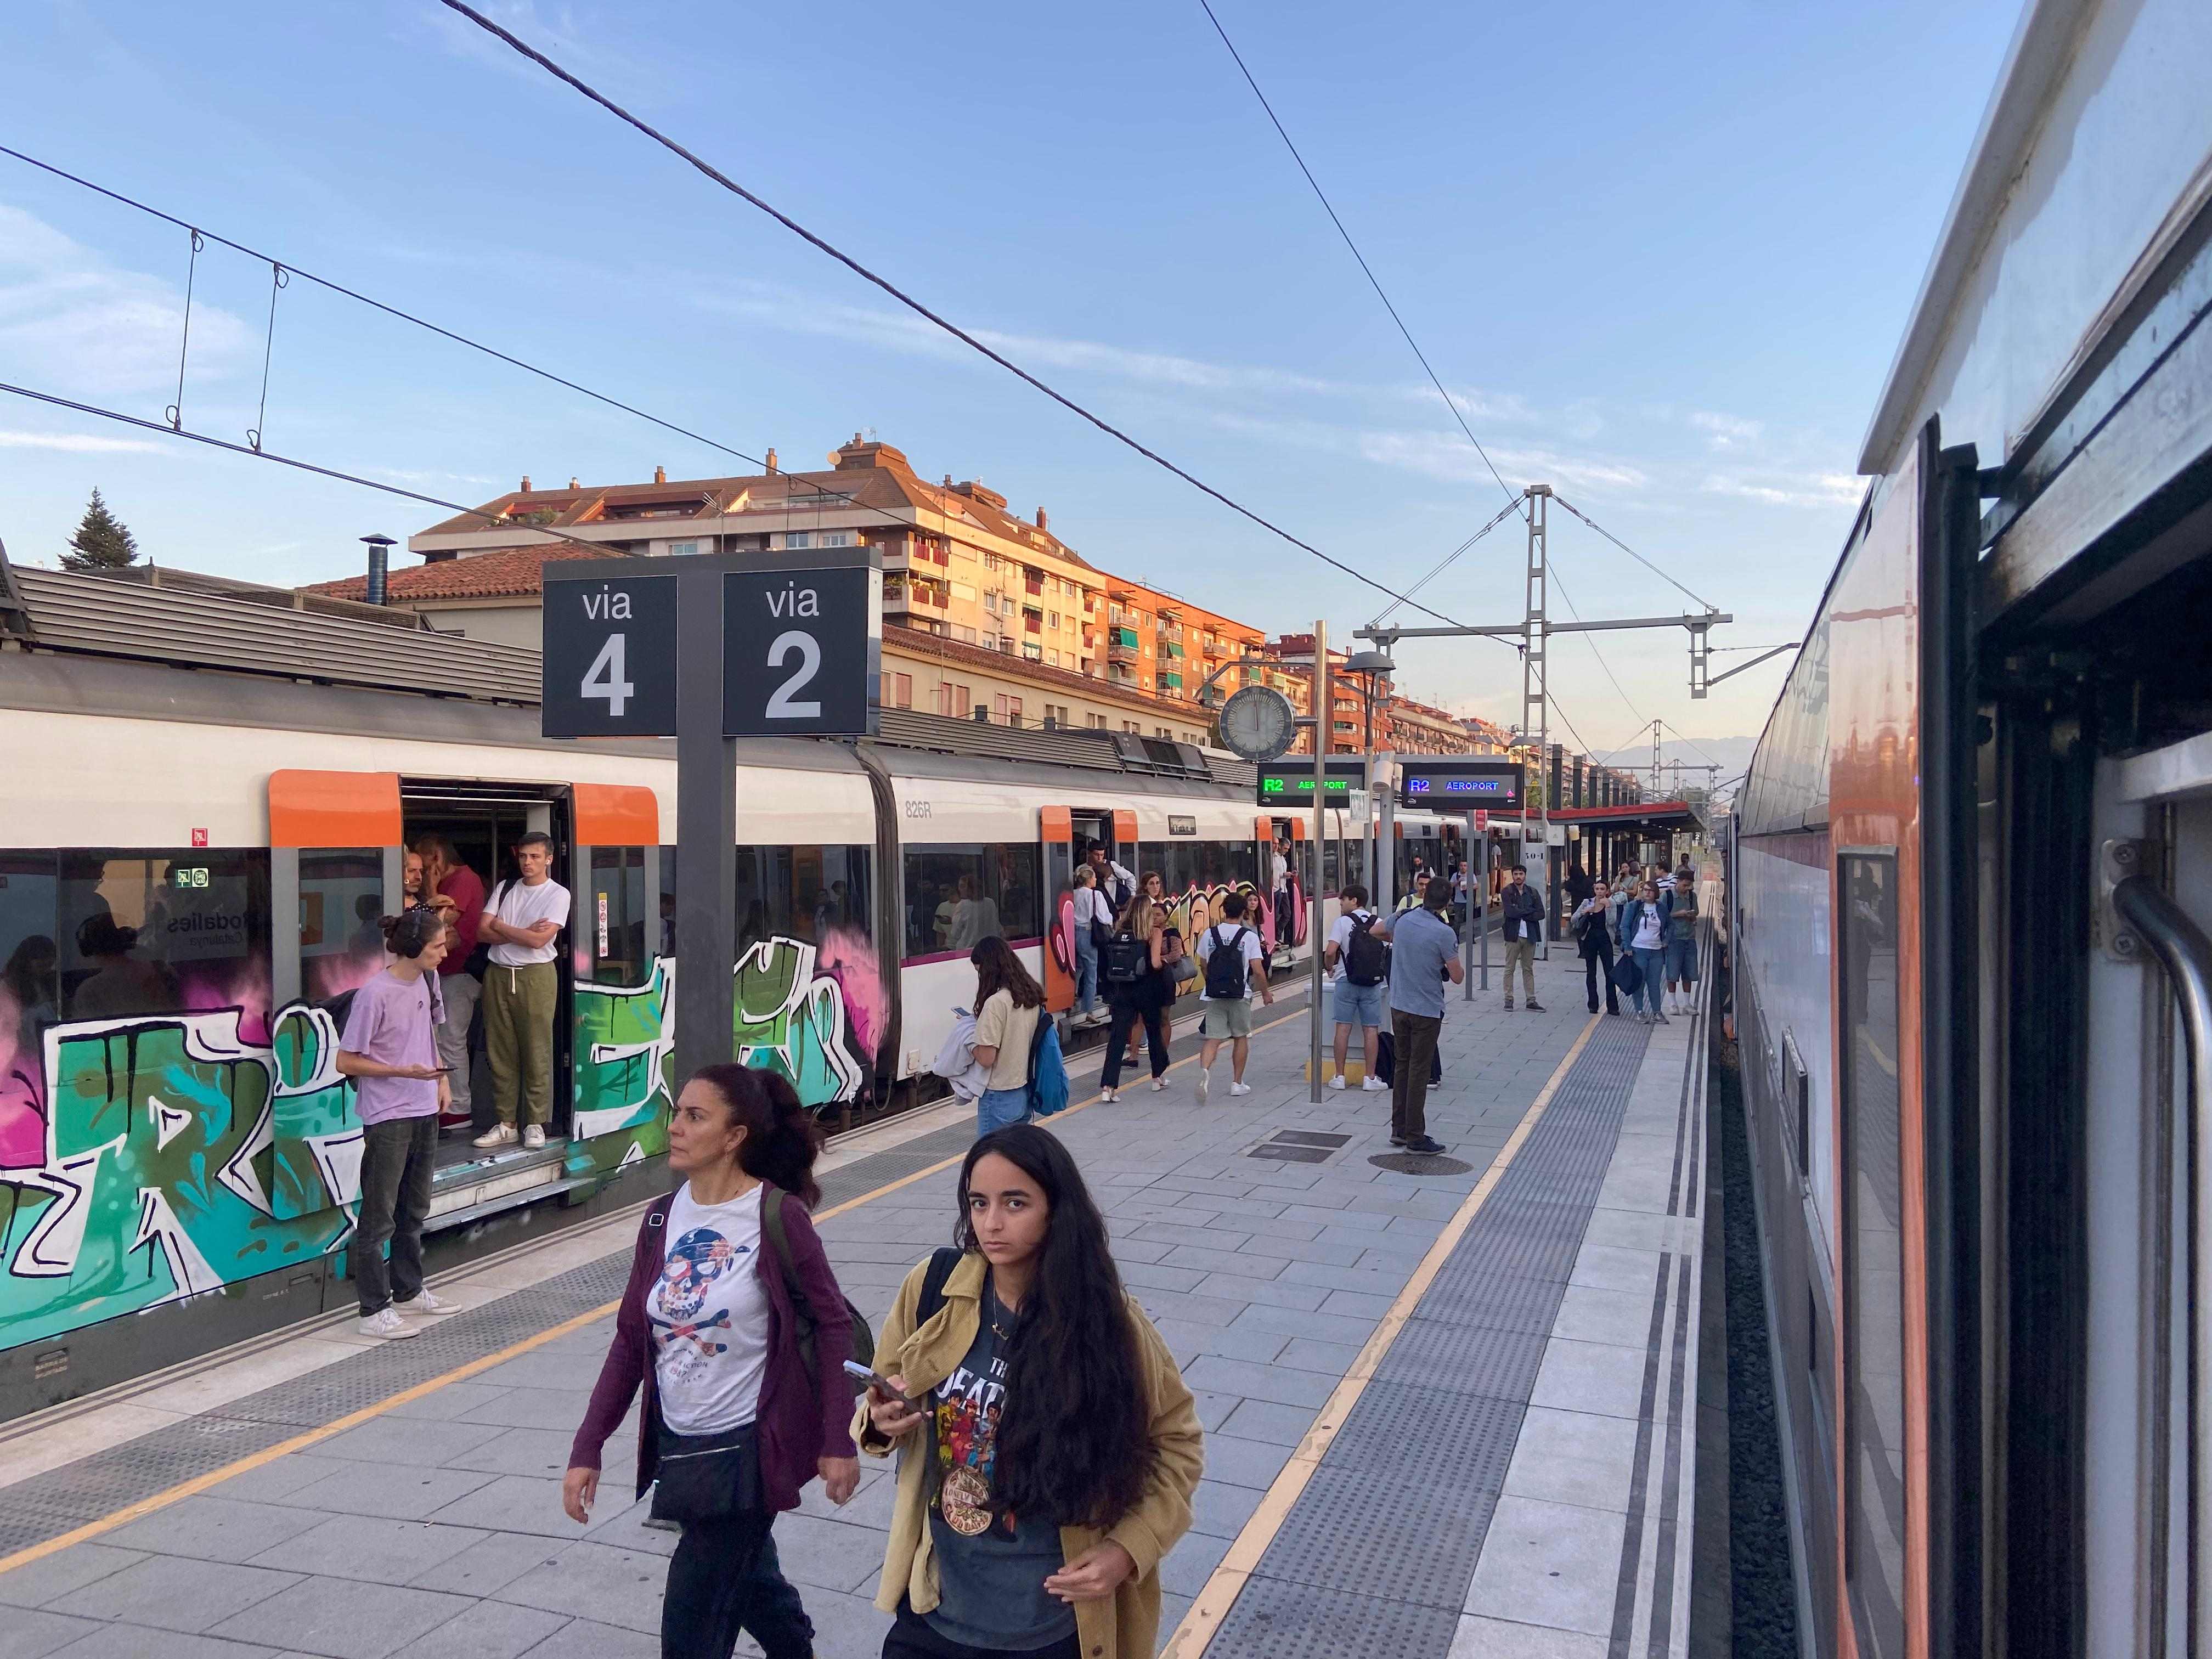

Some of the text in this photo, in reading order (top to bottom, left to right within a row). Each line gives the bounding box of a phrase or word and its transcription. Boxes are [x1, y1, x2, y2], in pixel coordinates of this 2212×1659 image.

[582, 584, 633, 620] via
[765, 580, 820, 618] via
[580, 633, 634, 716] 4
[765, 630, 821, 718] 2
[1264, 778, 1347, 791] R2 AERPORT
[1410, 779, 1499, 792] R2 AEROPORT
[905, 800, 932, 819] 826R
[990, 1357, 1008, 1378] TH
